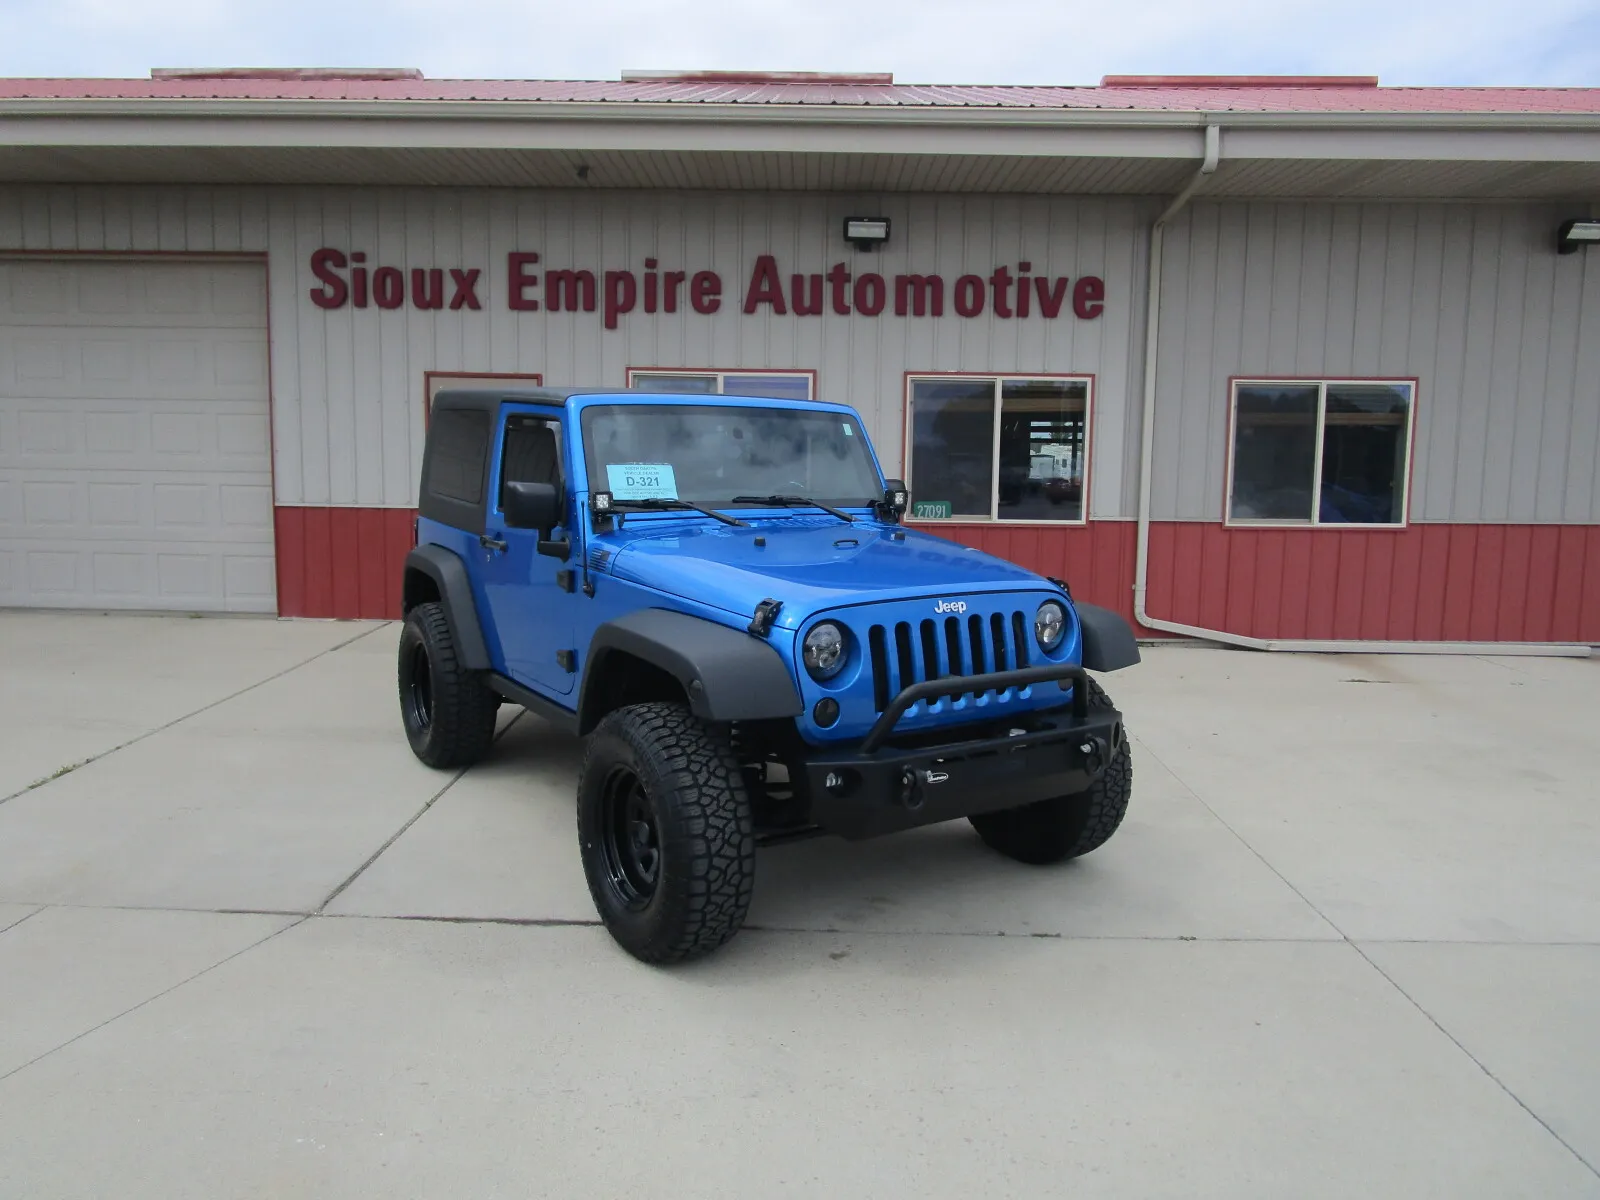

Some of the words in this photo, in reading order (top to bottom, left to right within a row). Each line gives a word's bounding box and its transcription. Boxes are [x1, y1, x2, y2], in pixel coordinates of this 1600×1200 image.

[310, 248, 481, 310] Sioux
[508, 254, 721, 329] Empire
[743, 255, 1104, 320] Automotive
[626, 476, 660, 487] D-321
[917, 504, 946, 519] 27091
[934, 600, 967, 614] Jeep
